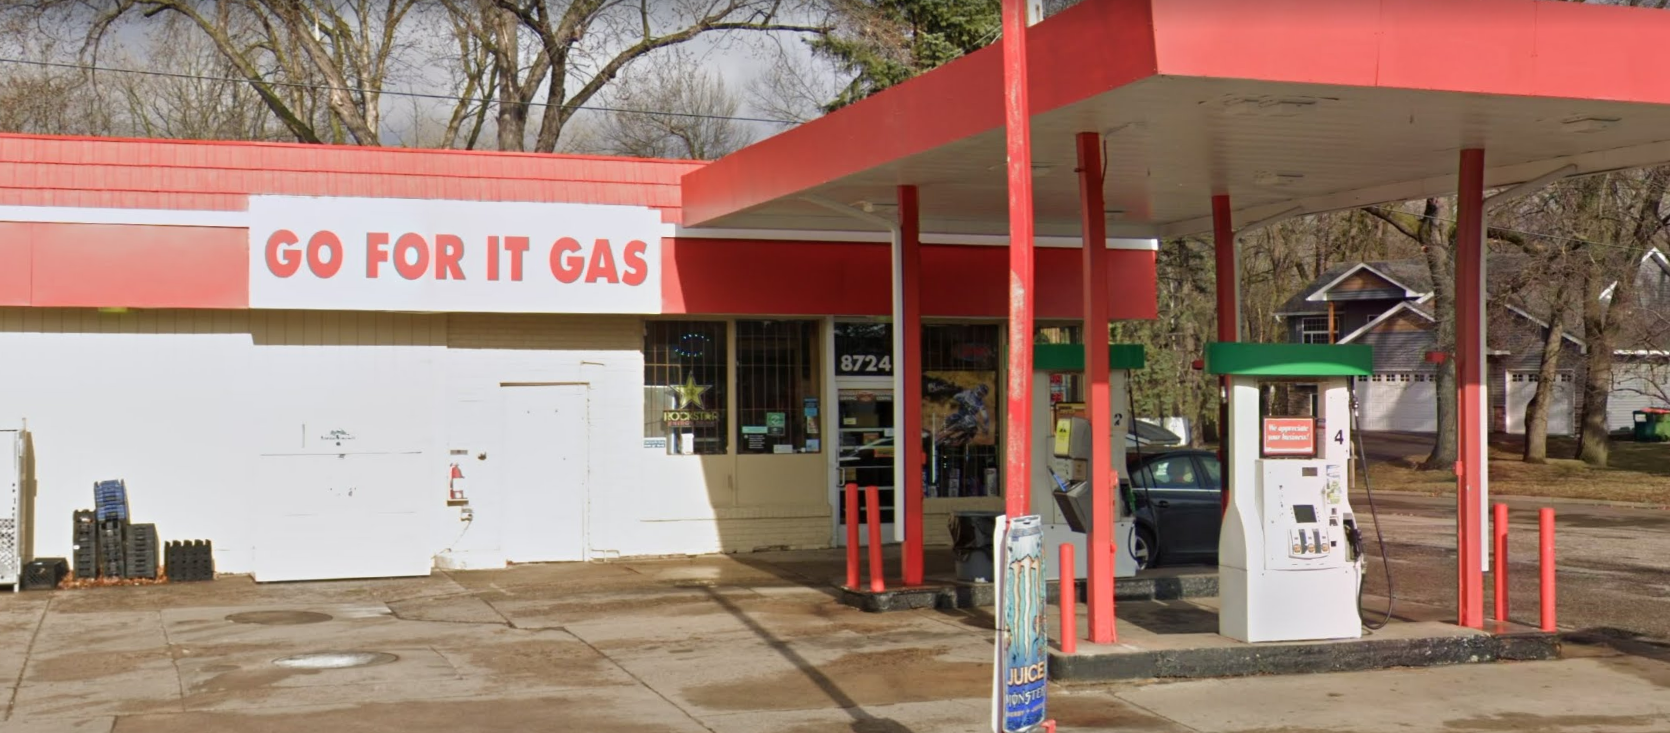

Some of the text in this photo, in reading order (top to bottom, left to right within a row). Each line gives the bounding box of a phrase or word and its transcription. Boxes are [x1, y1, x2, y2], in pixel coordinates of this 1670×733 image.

[265, 228, 649, 287] GO FOR IT GAS
[840, 354, 892, 371] 8724
[1113, 412, 1123, 426] 2
[1268, 423, 1278, 431] We
[1334, 429, 1344, 445] 4
[1007, 661, 1045, 686] JUICE
